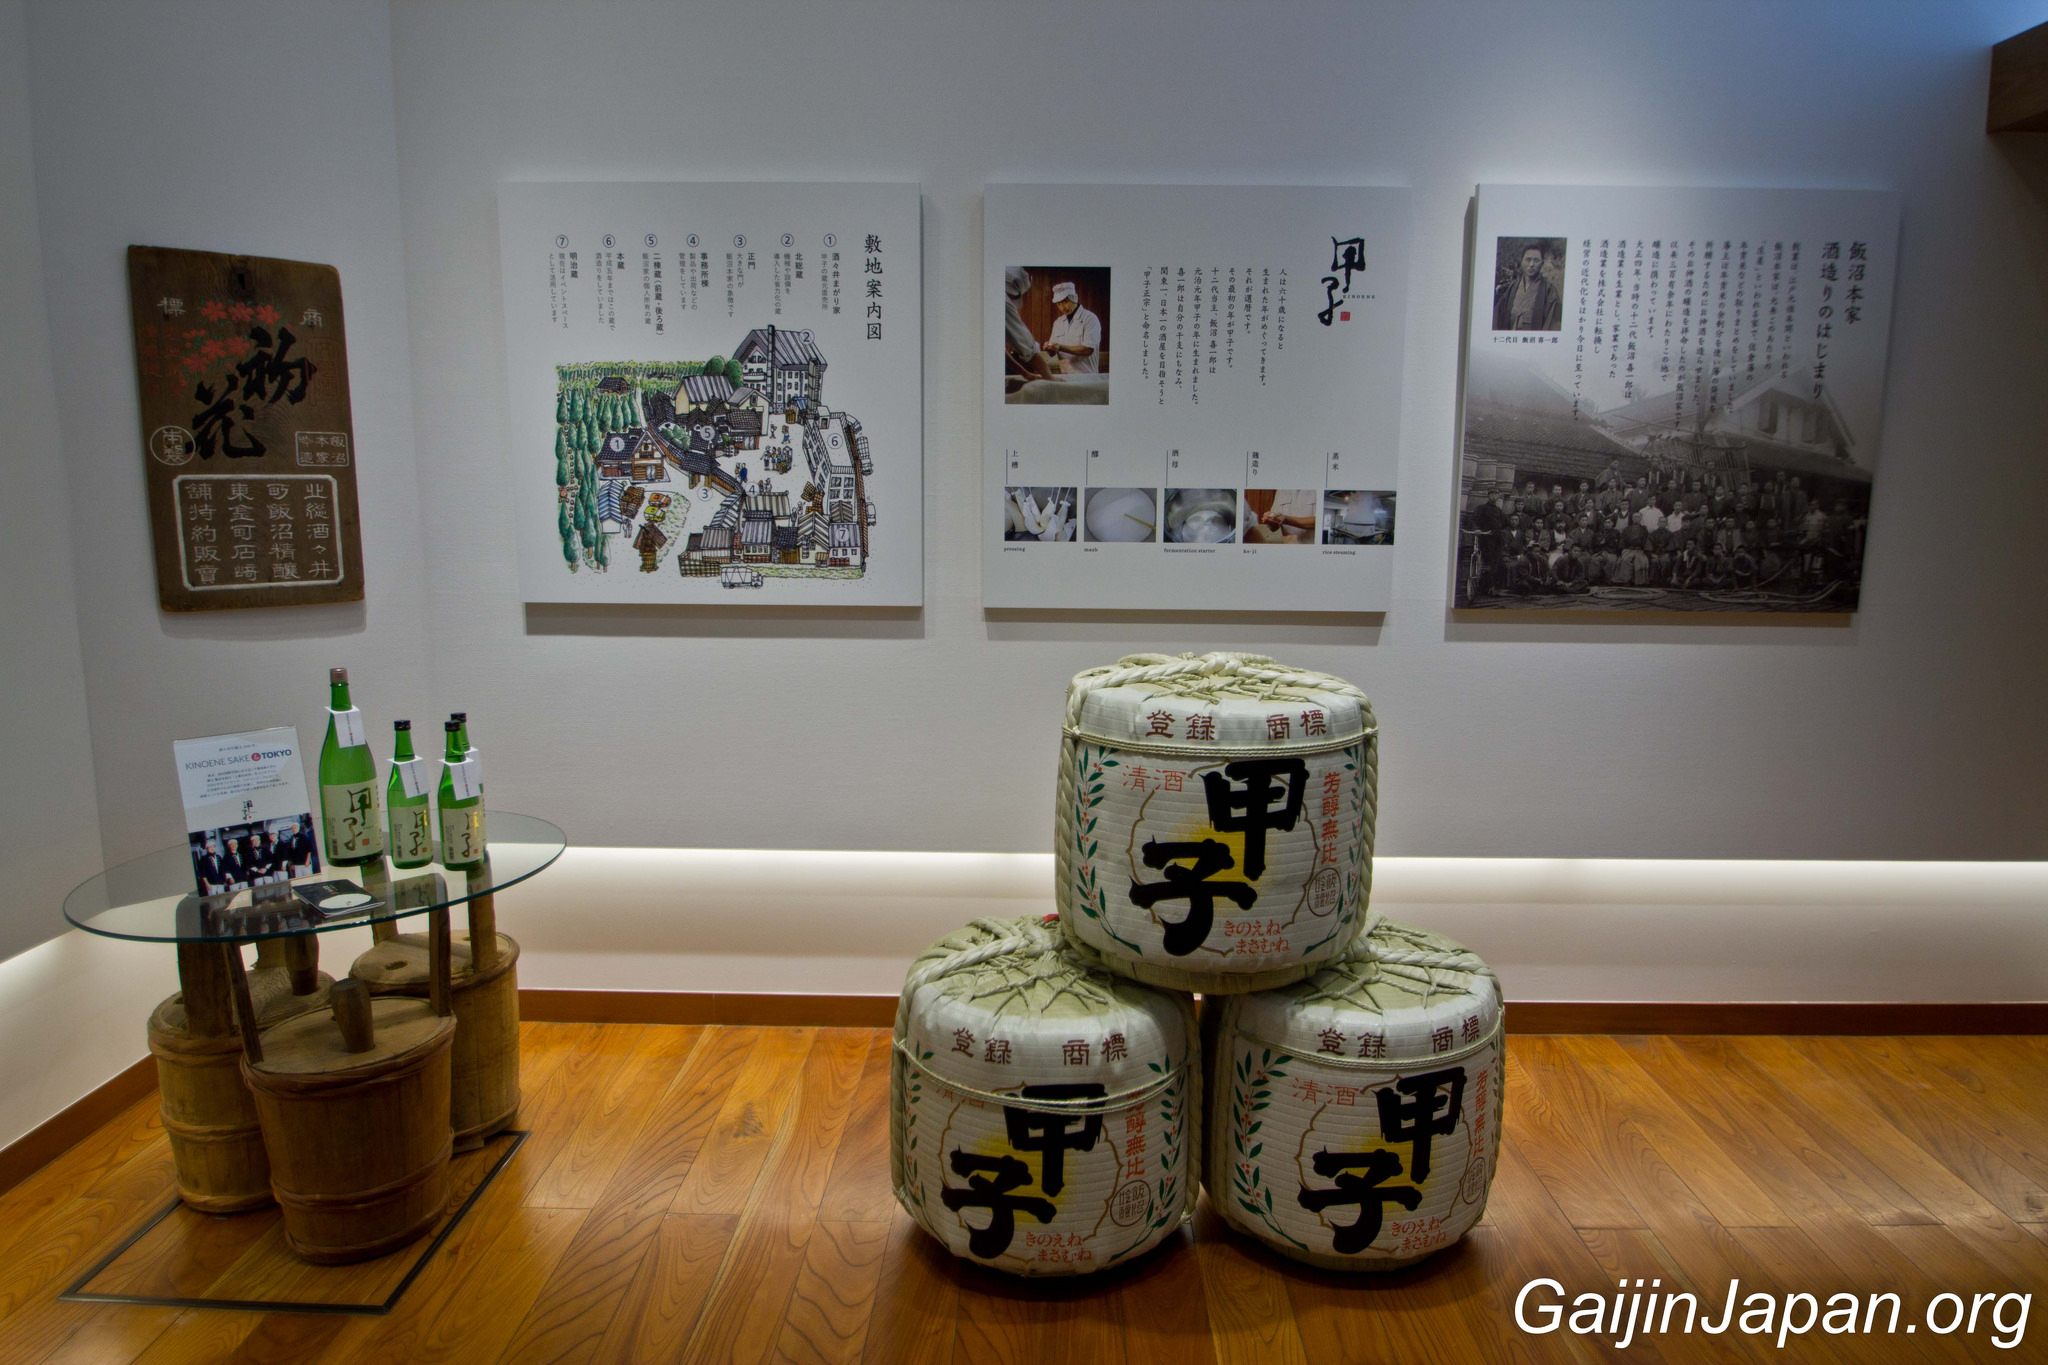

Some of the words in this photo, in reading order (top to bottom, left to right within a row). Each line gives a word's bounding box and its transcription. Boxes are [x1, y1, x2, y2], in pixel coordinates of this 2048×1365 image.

[569, 252, 579, 279] 明治蔵
[616, 252, 625, 270] 本蔵
[700, 252, 709, 288] 事務所棟
[736, 253, 744, 288] 大きな門が
[747, 252, 756, 270] 正門
[795, 252, 804, 279] 北総蔵
[831, 252, 841, 315] 酒々井まがり家
[864, 234, 884, 341] 敷地案内図
[1243, 267, 1253, 334] それが還暦です。
[1845, 241, 1868, 325] 飯沼本家
[157, 297, 187, 317] 標
[300, 309, 323, 328] 商
[1141, 266, 1152, 379] 「甲子正宗」と命名しました。
[1226, 267, 1236, 368] その最初の年が甲子です。
[1278, 268, 1288, 350] 人は六十歳になると
[1813, 241, 1840, 400] 酒造りのはじまり
[1175, 267, 1186, 389] 喜一郎は自分の干支にちなみ、
[1191, 267, 1203, 405] 元治元年甲子の年に生まれました。
[1259, 268, 1270, 386] 生まれた年がめぐってきます。
[1171, 449, 1180, 469] 酒母
[1145, 710, 1216, 741] 登録
[1266, 710, 1328, 741] 商標
[185, 758, 227, 770] KINOENE
[228, 754, 251, 765] SAKE
[261, 749, 292, 760] TOKYO
[1123, 764, 1188, 792] 清酒
[343, 787, 373, 852] 甲子
[1320, 771, 1341, 866] 芳醇無比
[1129, 757, 1310, 957] 甲子
[1224, 919, 1282, 937] きのえね
[1235, 936, 1290, 954] まさむね
[951, 1027, 1013, 1065] 登録
[1062, 1033, 1129, 1066] 商標
[1316, 1027, 1387, 1059] 登録
[1431, 1015, 1481, 1054] 商標
[1291, 1077, 1360, 1107] 清酒
[940, 1082, 1109, 1259] 甲子
[1297, 1066, 1467, 1255] 甲子
[1025, 1231, 1084, 1249] きのえね
[1392, 1218, 1442, 1237] きのえね
[1401, 1233, 1447, 1251] まさむね
[1037, 1246, 1093, 1264] まさむね
